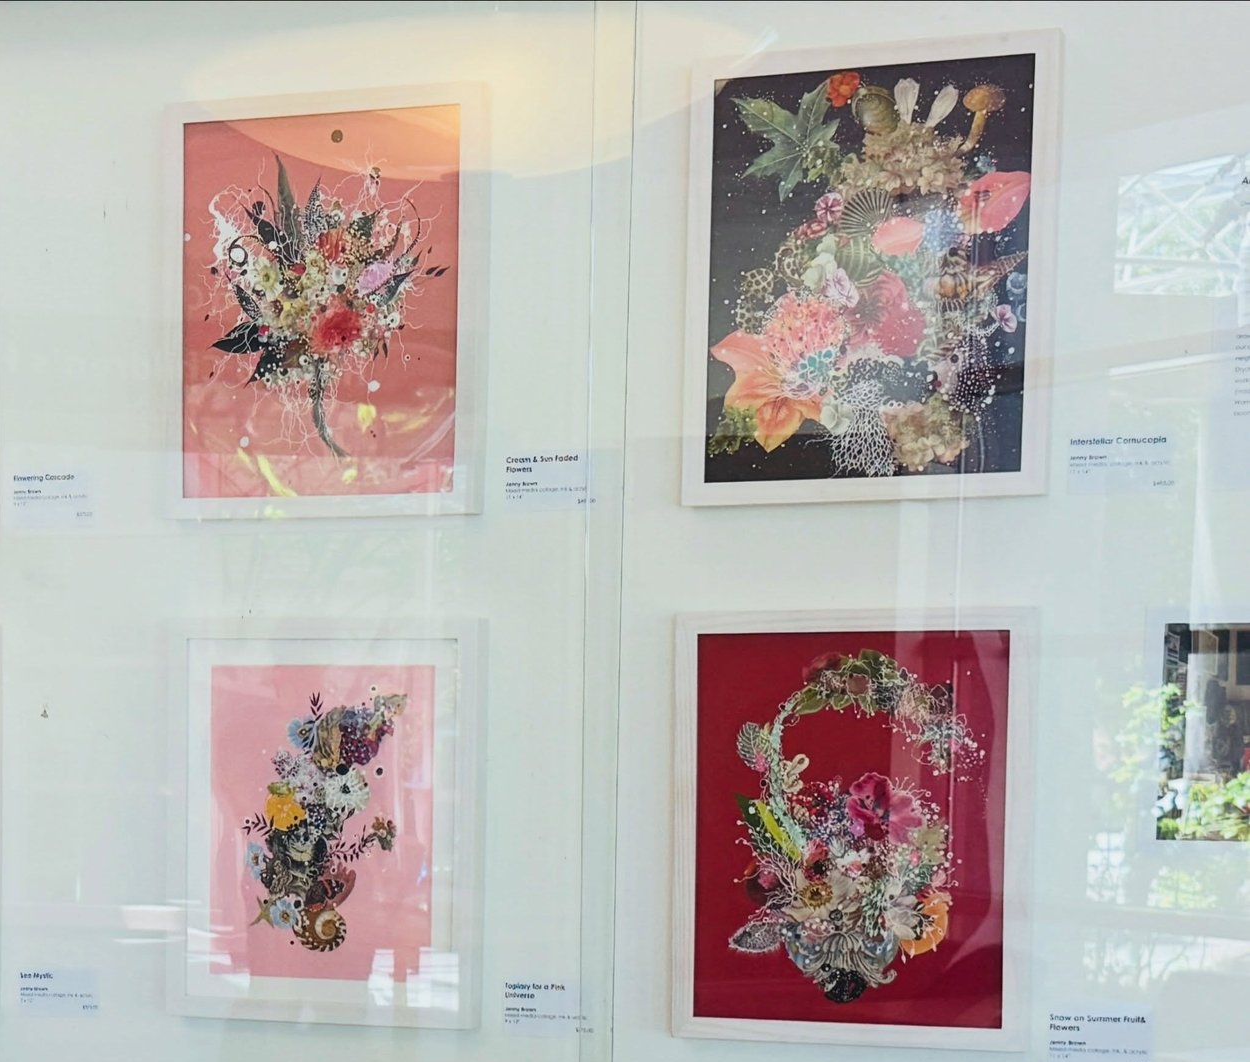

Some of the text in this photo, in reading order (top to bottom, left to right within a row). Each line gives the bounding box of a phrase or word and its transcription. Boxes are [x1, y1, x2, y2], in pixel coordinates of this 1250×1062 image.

[1070, 436, 1167, 446] Interstellar Cornucopia
[506, 456, 531, 464] Cream
[555, 454, 579, 462] Faded
[45, 473, 75, 481] Cascade
[550, 983, 565, 991] Pink
[1049, 1013, 1071, 1021] Snow
[1087, 1015, 1121, 1023] Summer
[1049, 1023, 1080, 1032] Flowers
